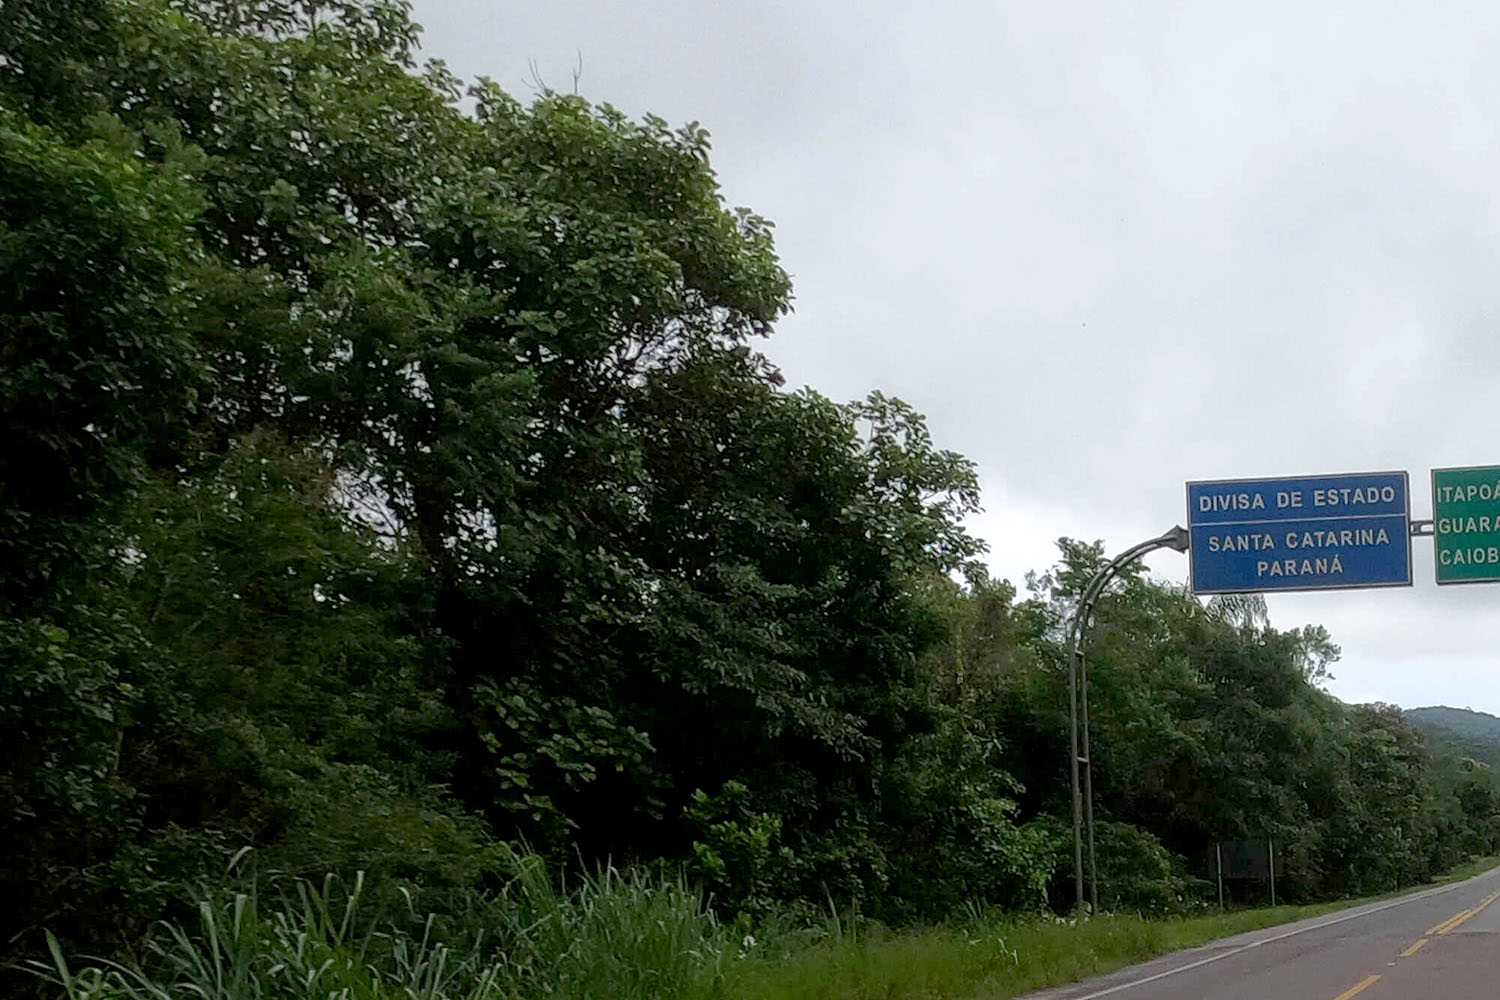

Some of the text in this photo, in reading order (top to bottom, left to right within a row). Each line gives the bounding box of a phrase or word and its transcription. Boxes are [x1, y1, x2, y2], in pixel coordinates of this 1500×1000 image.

[1199, 486, 1395, 512] DIVISA DE ESTADO
[1208, 529, 1390, 552] SANTA CATARINA
[1257, 554, 1343, 577] PARANÁ
